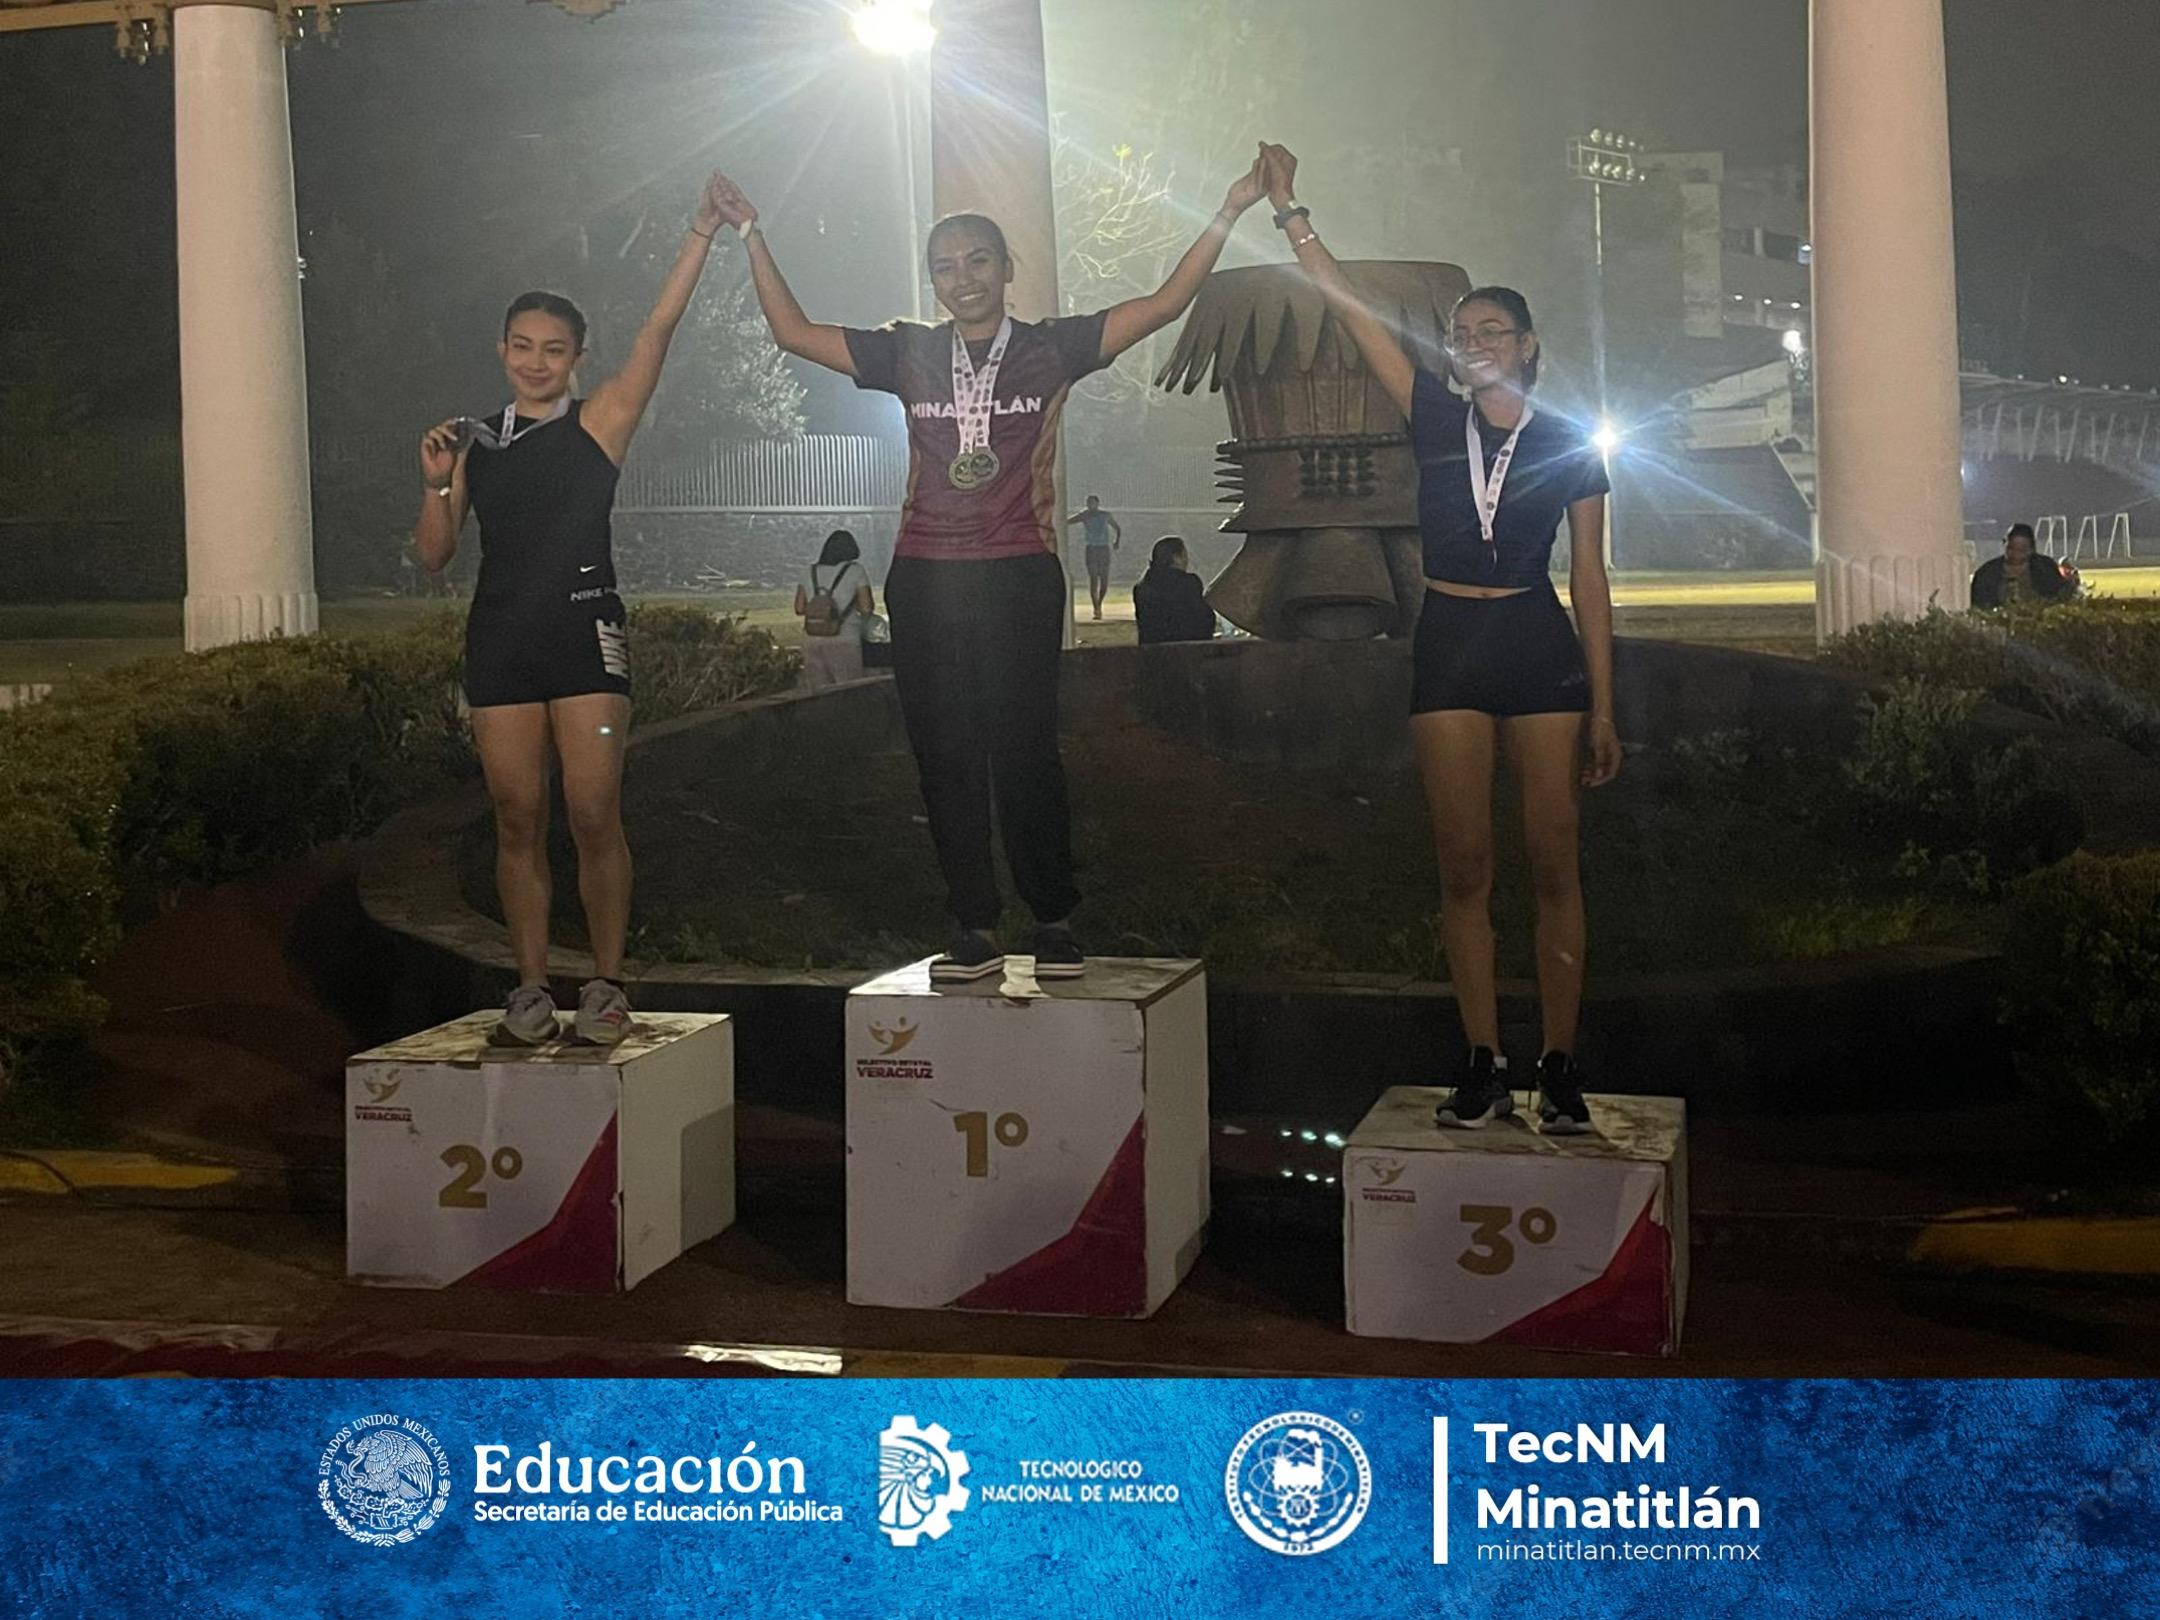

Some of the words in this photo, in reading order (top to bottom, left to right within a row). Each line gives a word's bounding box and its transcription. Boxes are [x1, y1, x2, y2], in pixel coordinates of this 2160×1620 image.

[911, 395, 1041, 418] MINALÁN
[570, 587, 603, 601] NIKE
[596, 619, 629, 679] NIKE
[856, 1067, 934, 1079] VERACRUZ
[355, 1112, 413, 1122] VERACRUZ
